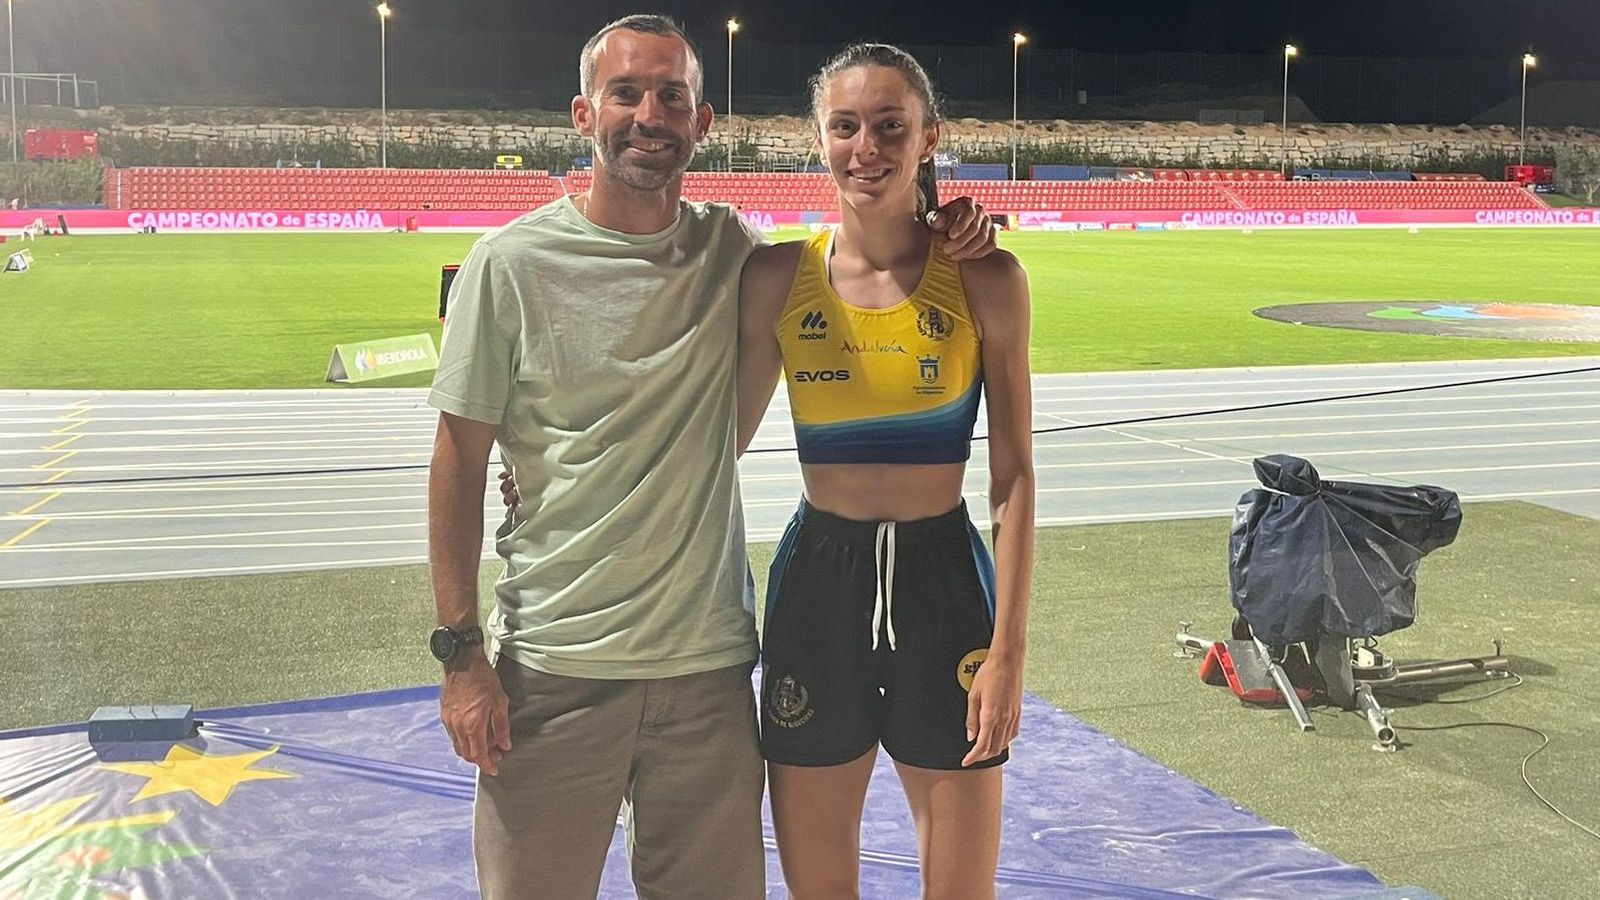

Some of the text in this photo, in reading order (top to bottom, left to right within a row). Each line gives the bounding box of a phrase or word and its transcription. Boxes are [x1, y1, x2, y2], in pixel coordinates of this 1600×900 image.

[128, 209, 384, 228] CAMPEONATO de ESPAÑA
[1182, 209, 1359, 225] CAMPEONATO de ESPAÑA
[1476, 211, 1573, 224] CAMPEONATO
[1576, 212, 1590, 223] de
[377, 347, 428, 365] IBERDROLA
[795, 370, 850, 382] EVOS
